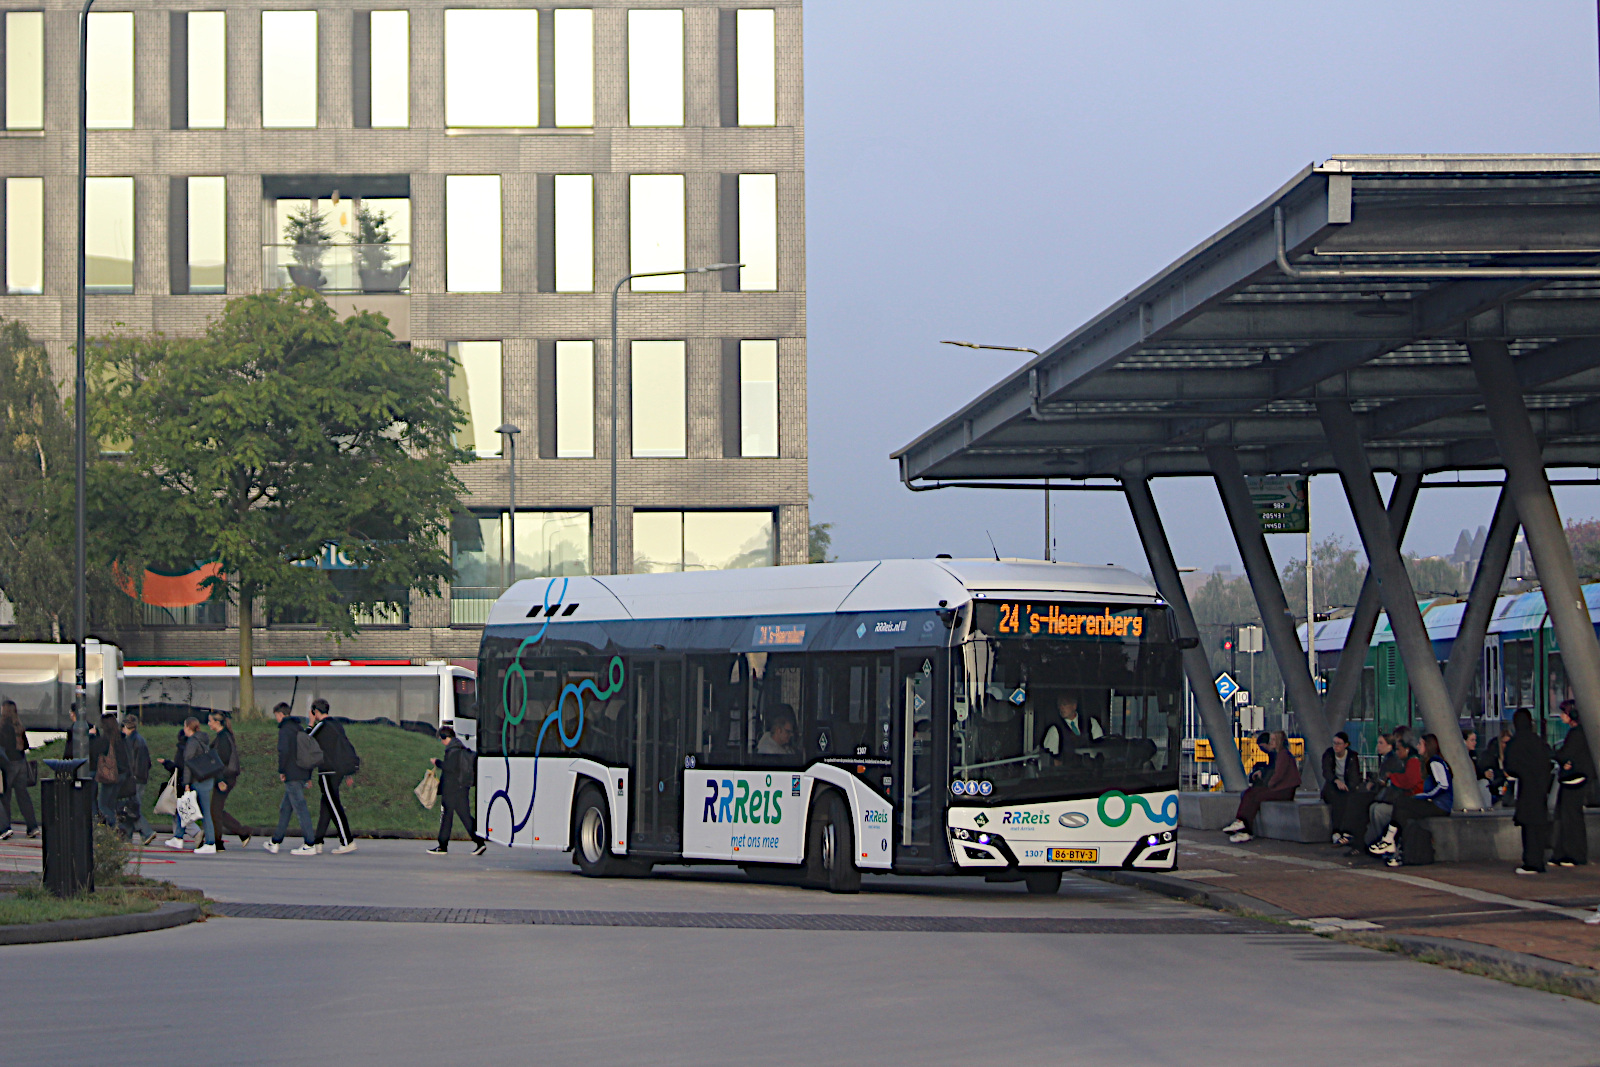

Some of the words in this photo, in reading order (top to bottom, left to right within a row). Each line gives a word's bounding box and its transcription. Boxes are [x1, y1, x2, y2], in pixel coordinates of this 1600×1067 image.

[999, 603, 1019, 633] 24
[1026, 604, 1143, 637] 's-Heerenberg
[1219, 681, 1230, 694] 2
[1018, 693, 1025, 702] 4
[702, 774, 783, 824] RRReis
[864, 808, 888, 823] RRReis
[1003, 810, 1050, 824] RRReis
[731, 834, 746, 848] met
[747, 836, 761, 848] ons
[762, 836, 779, 849] mee
[1025, 850, 1044, 858] 1307
[1055, 850, 1093, 859] 86-BTV-3
